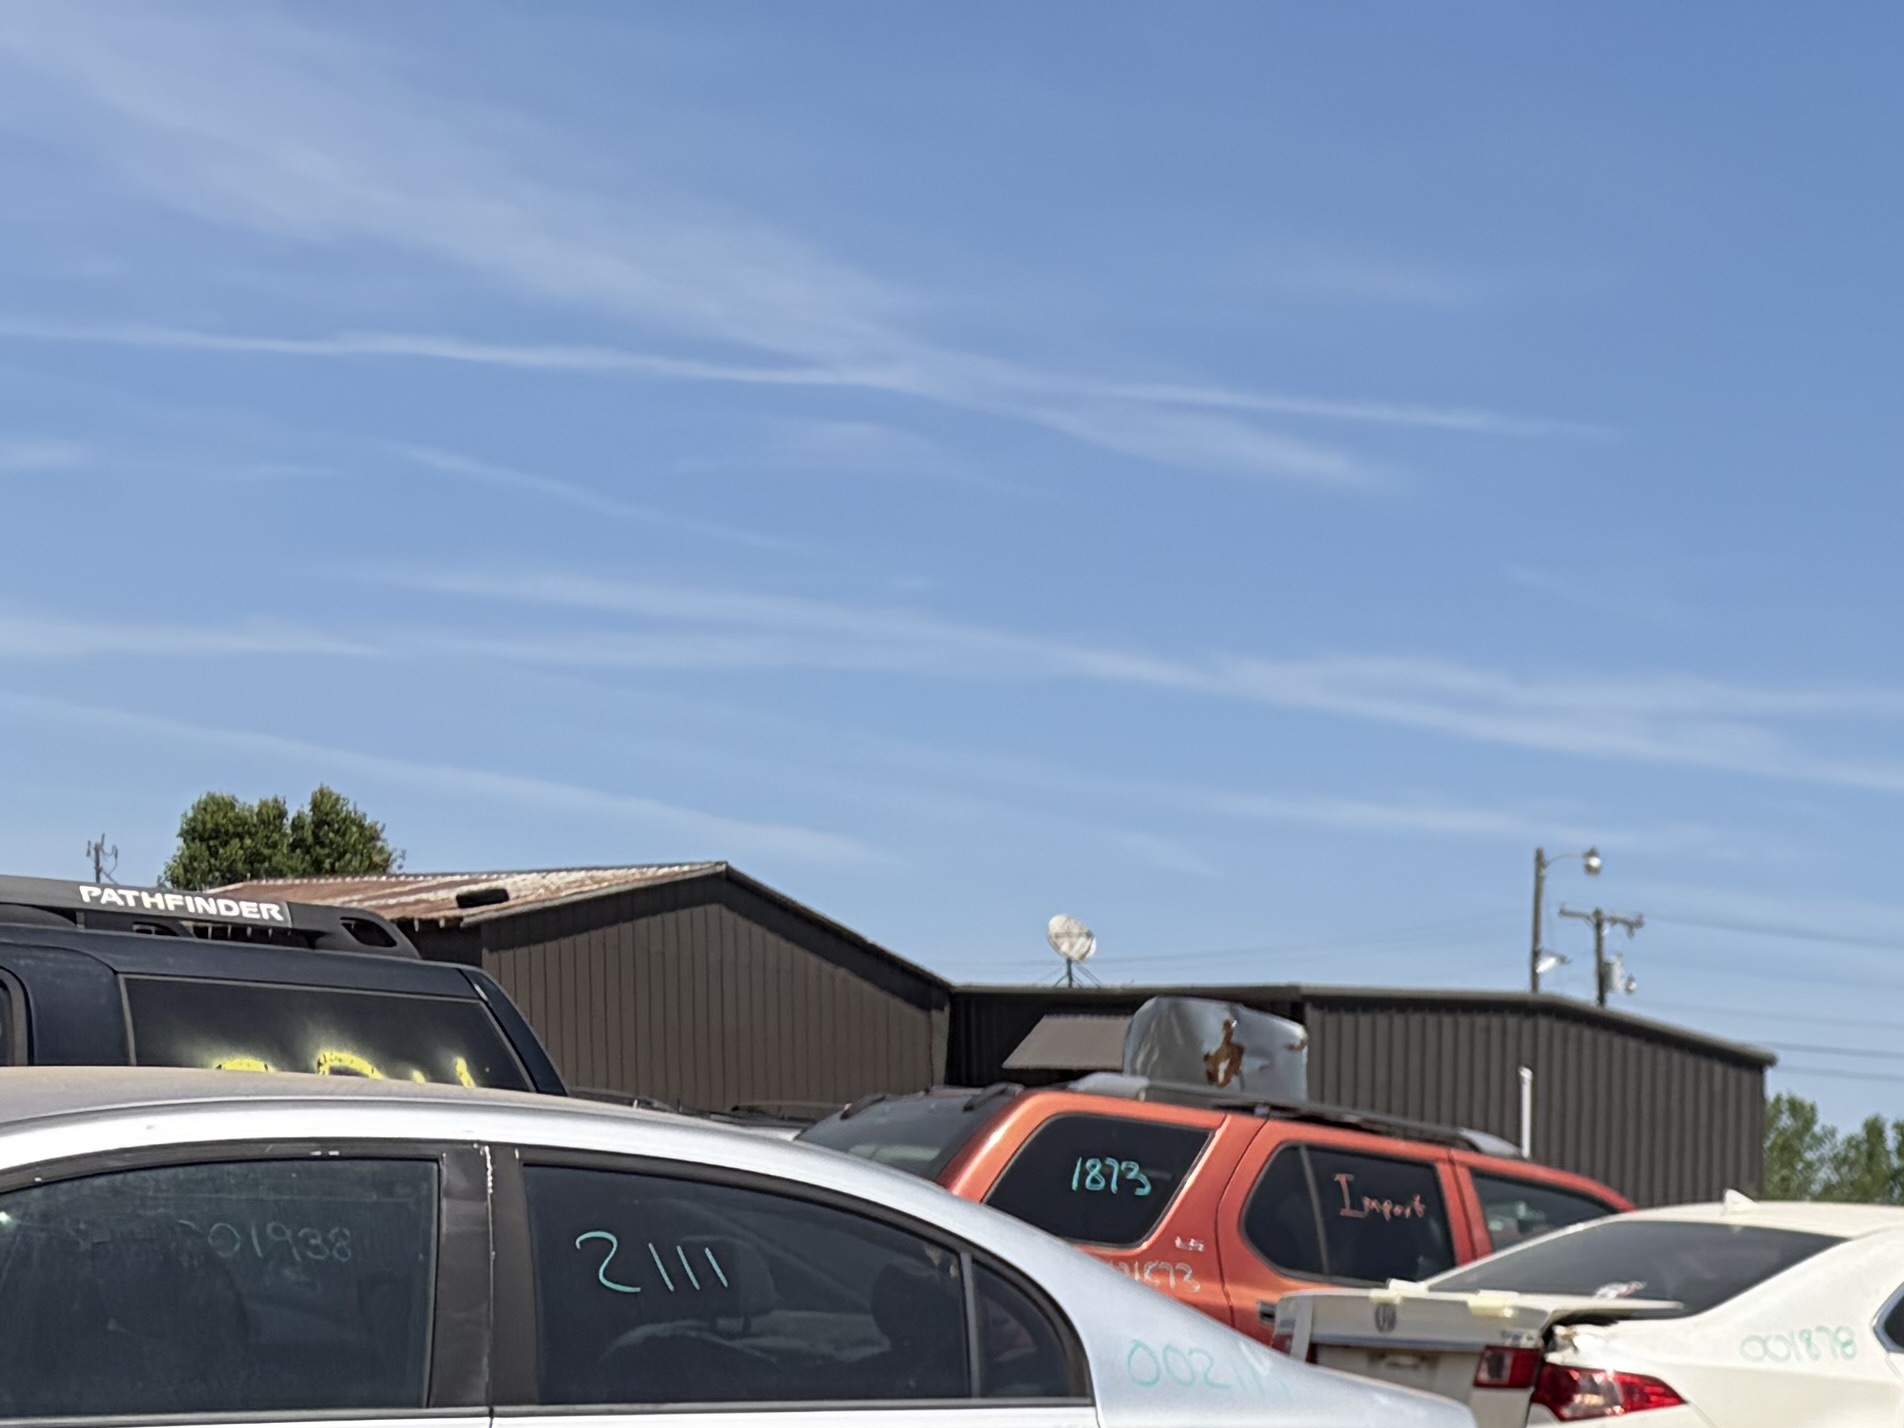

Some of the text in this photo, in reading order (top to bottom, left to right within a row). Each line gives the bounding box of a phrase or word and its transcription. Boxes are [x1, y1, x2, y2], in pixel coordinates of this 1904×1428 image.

[79, 885, 284, 922] PATHFINDER
[1072, 1157, 1152, 1196] 1873
[575, 1230, 729, 1293] 2111
